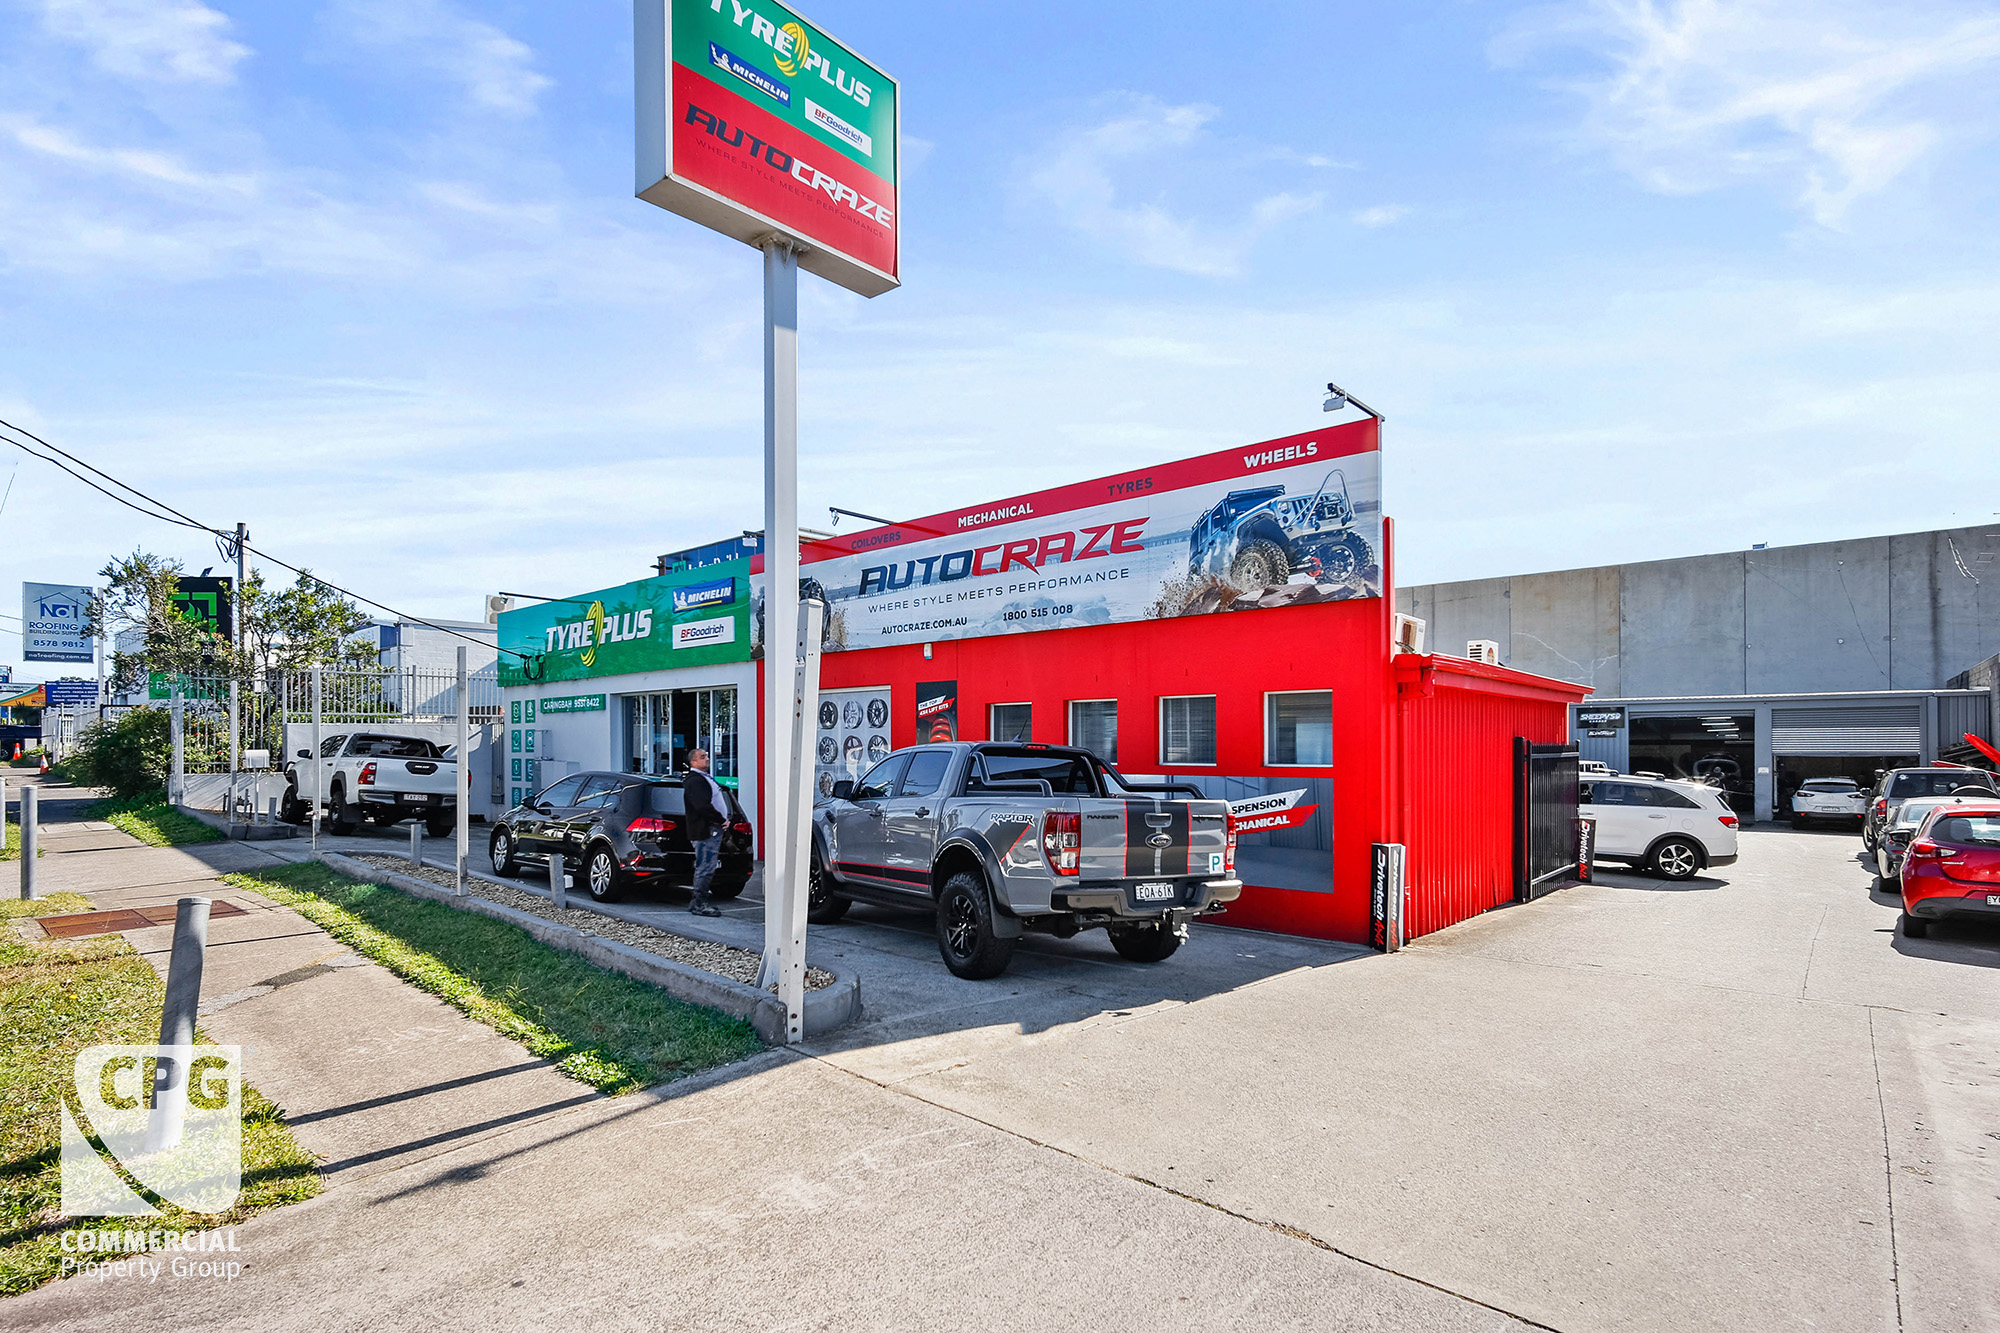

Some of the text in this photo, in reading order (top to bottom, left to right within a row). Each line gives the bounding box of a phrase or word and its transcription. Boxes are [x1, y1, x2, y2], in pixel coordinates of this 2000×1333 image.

[732, 62, 789, 102] MICHELIN
[815, 108, 863, 143] BFGoodrich
[685, 102, 894, 229] AUTOCRAZE
[696, 138, 884, 239] WHERE STYLE MEETS PERFORMANCE
[1243, 442, 1318, 469] WHEELS
[1107, 477, 1153, 496] TYRES
[958, 502, 1034, 528] MECHANICAL
[851, 531, 902, 550] COILOVERS
[859, 516, 1151, 596] AUTOCRAZE
[687, 587, 732, 604] MICHELIN
[868, 568, 1130, 613] WHERE STYLE MEETS PERFORMANCE
[1003, 605, 1073, 621] 1800 515 008
[29, 621, 79, 631] ROOFING
[680, 624, 725, 639] BFGoodrich
[881, 617, 968, 635] AUTOCRAZE.COM.AU
[33, 639, 85, 648] 8578 9812
[1232, 797, 1286, 814] SPENSION
[990, 812, 1036, 827] RAPTOR
[1235, 814, 1291, 831] CHANICAL
[1211, 855, 1221, 872] P
